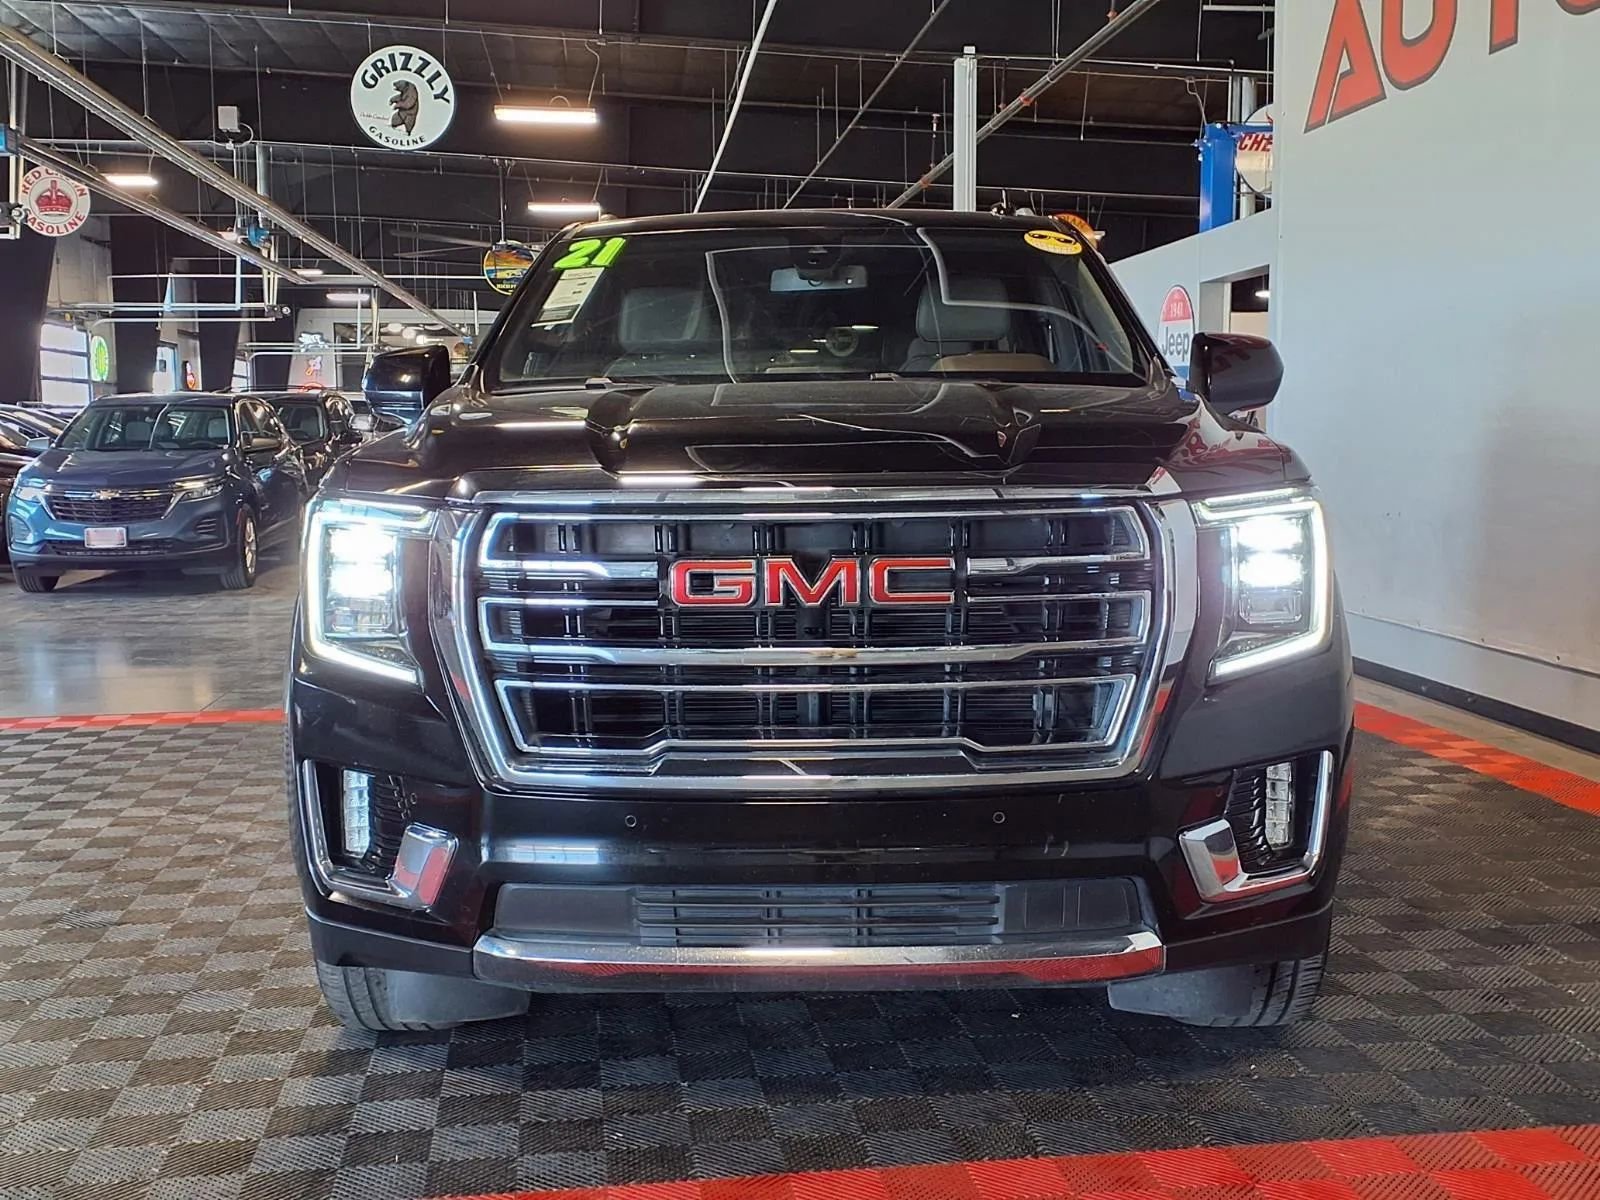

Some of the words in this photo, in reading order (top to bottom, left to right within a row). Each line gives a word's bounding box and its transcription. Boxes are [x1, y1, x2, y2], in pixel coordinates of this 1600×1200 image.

[361, 52, 451, 104] GRIZZLY
[1303, 0, 1600, 134] AU
[369, 126, 426, 147] GASOLINE
[22, 169, 42, 195] RED
[554, 237, 627, 269] 21
[1162, 326, 1190, 362] Jeep
[669, 556, 956, 607] GMC
